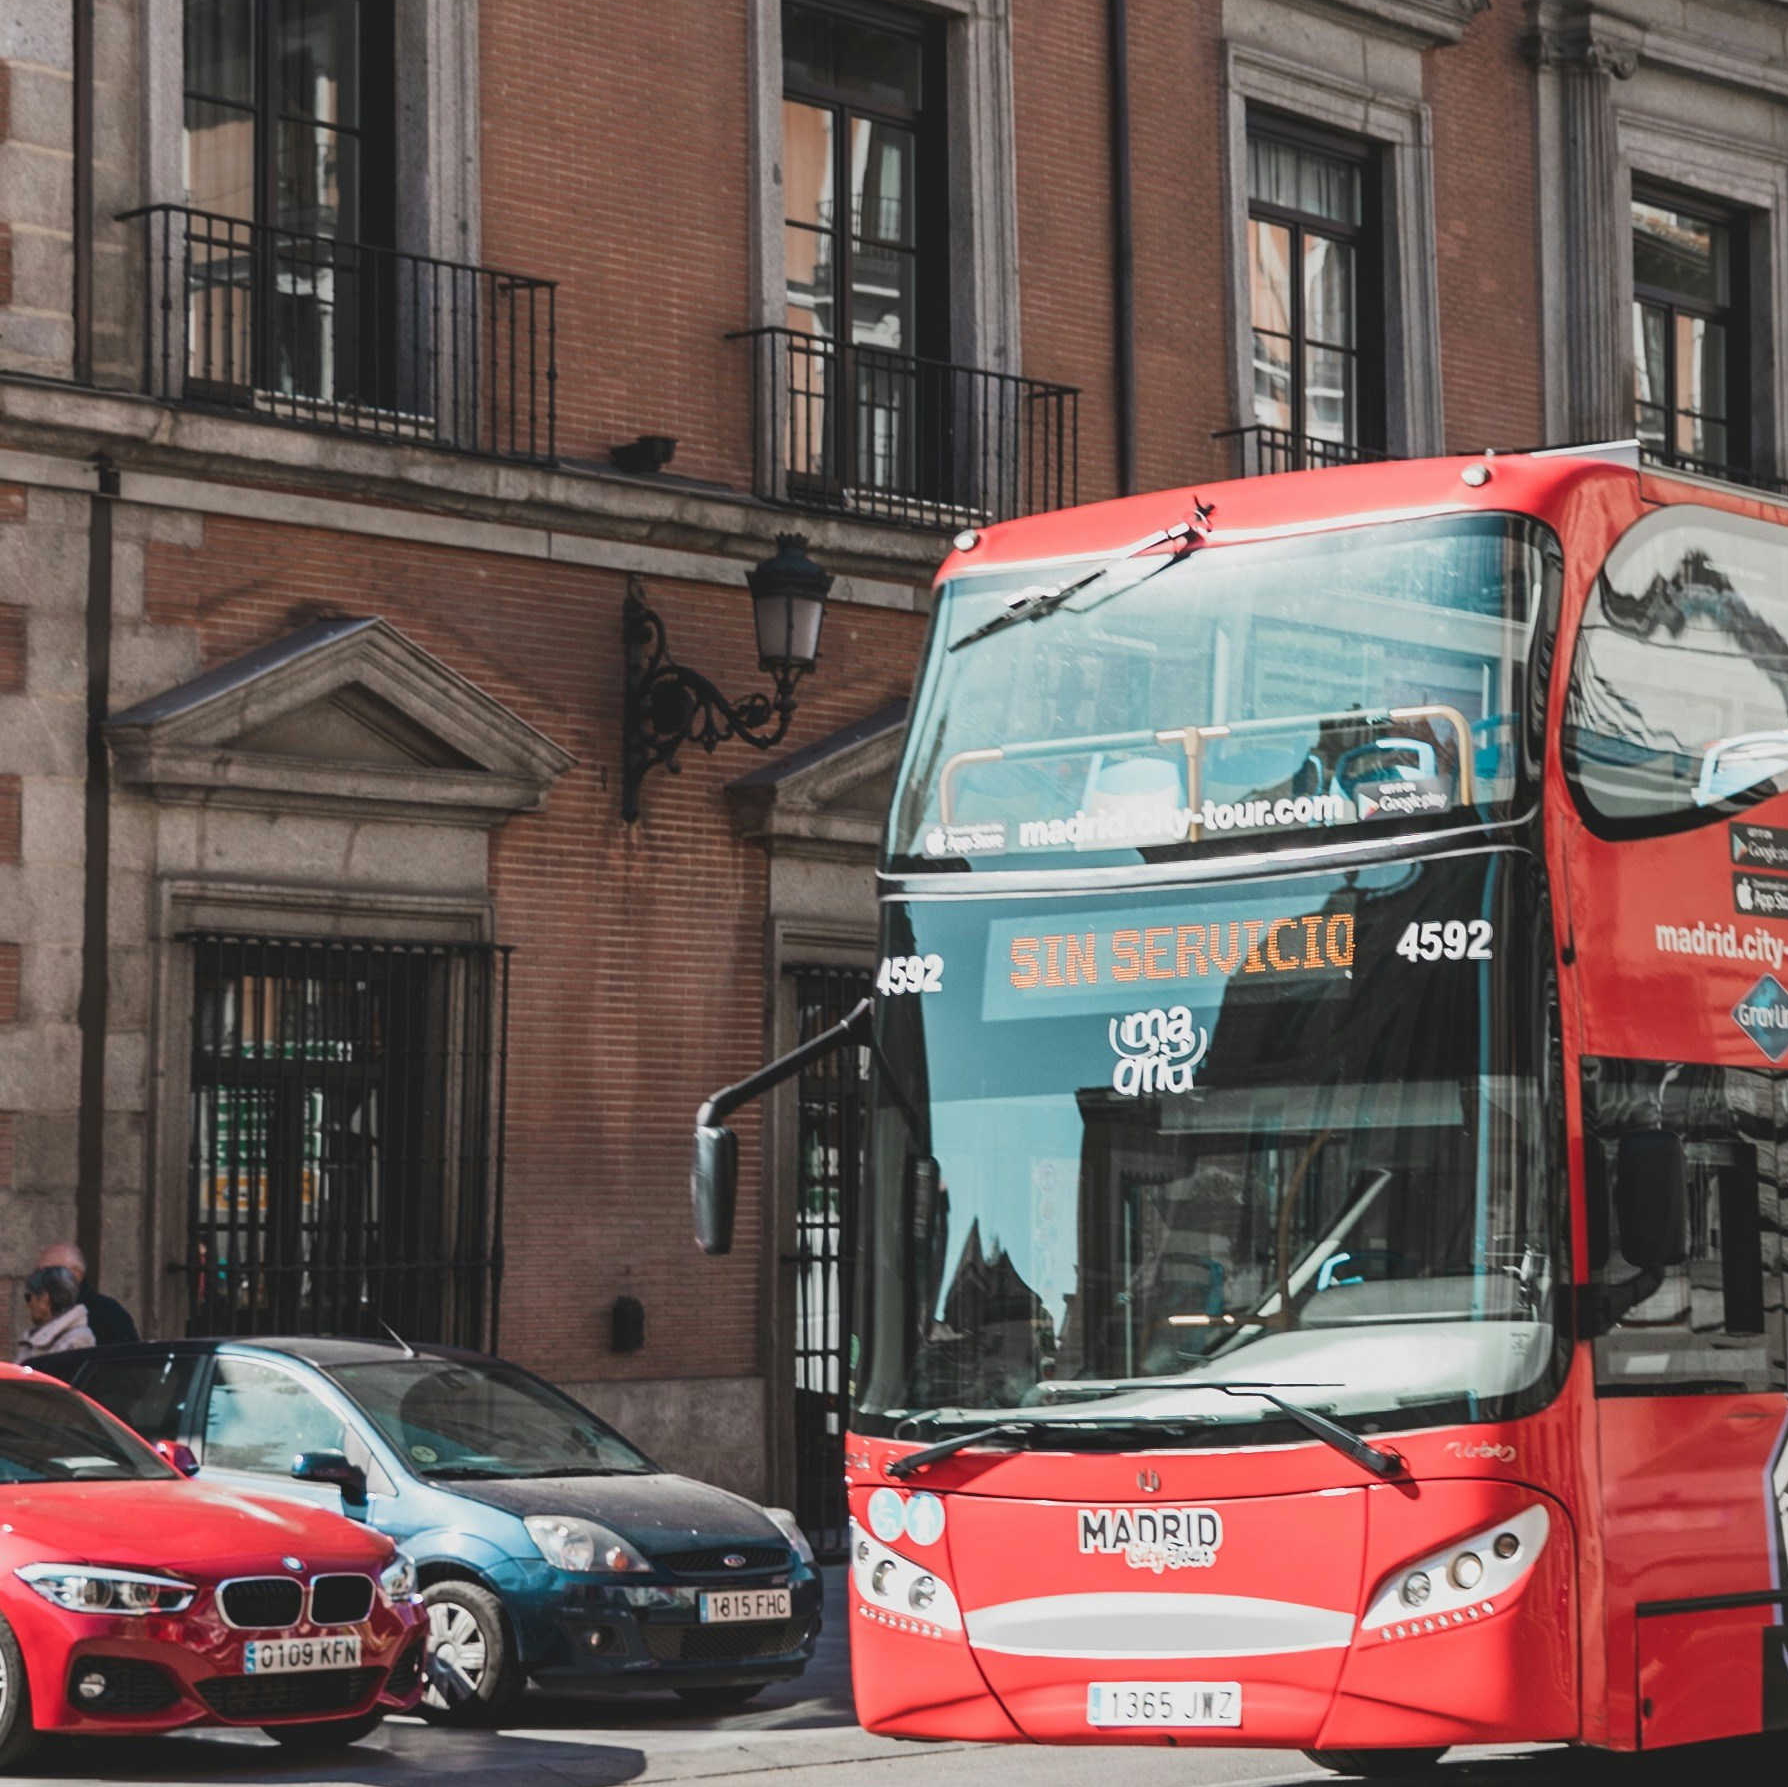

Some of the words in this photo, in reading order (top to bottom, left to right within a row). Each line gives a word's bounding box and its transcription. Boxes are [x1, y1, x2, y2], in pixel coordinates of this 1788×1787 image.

[1019, 794, 1345, 848] madrid.city-tour.com
[1009, 932, 1099, 990] SIN
[1111, 914, 1357, 983] SERVICIO
[1396, 919, 1494, 963] 4592
[875, 953, 944, 997] 4592
[1080, 1511, 1220, 1550] MADRID
[712, 1595, 752, 1618] 1815
[755, 1594, 787, 1616] FHC
[261, 1642, 314, 1668] 0109
[320, 1640, 357, 1665] KFN
[1112, 1691, 1174, 1719] 1365
